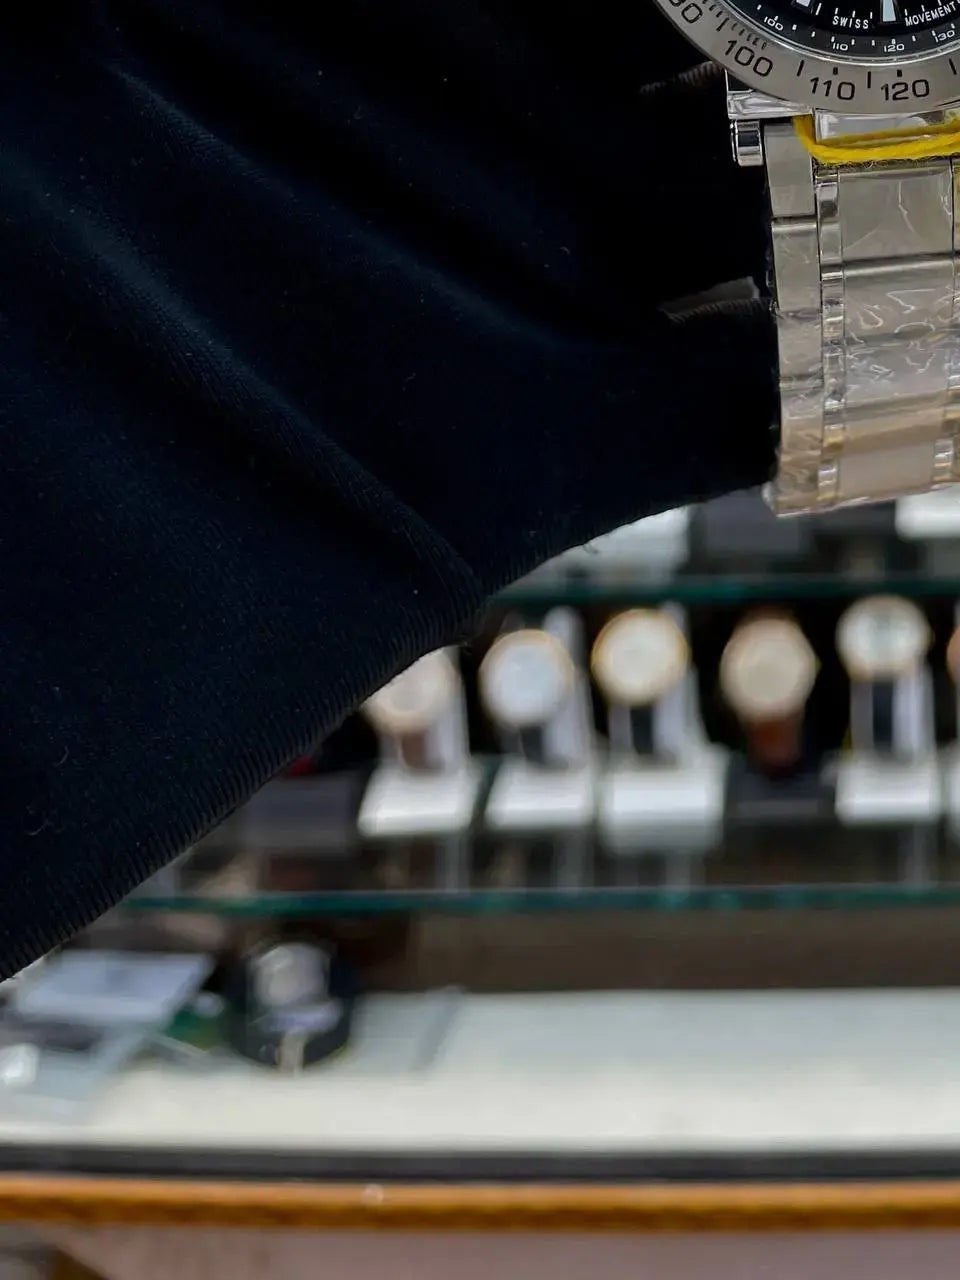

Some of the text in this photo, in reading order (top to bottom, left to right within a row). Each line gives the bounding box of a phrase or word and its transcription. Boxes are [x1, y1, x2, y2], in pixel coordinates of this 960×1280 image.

[764, 16, 784, 32] 100
[832, 2, 958, 30] SWISS MOVEMENT
[934, 29, 956, 43] 130
[832, 41, 849, 52] 110
[883, 41, 905, 53] 120
[724, 38, 774, 78] 100
[810, 77, 856, 101] 110
[880, 78, 930, 102] 120
